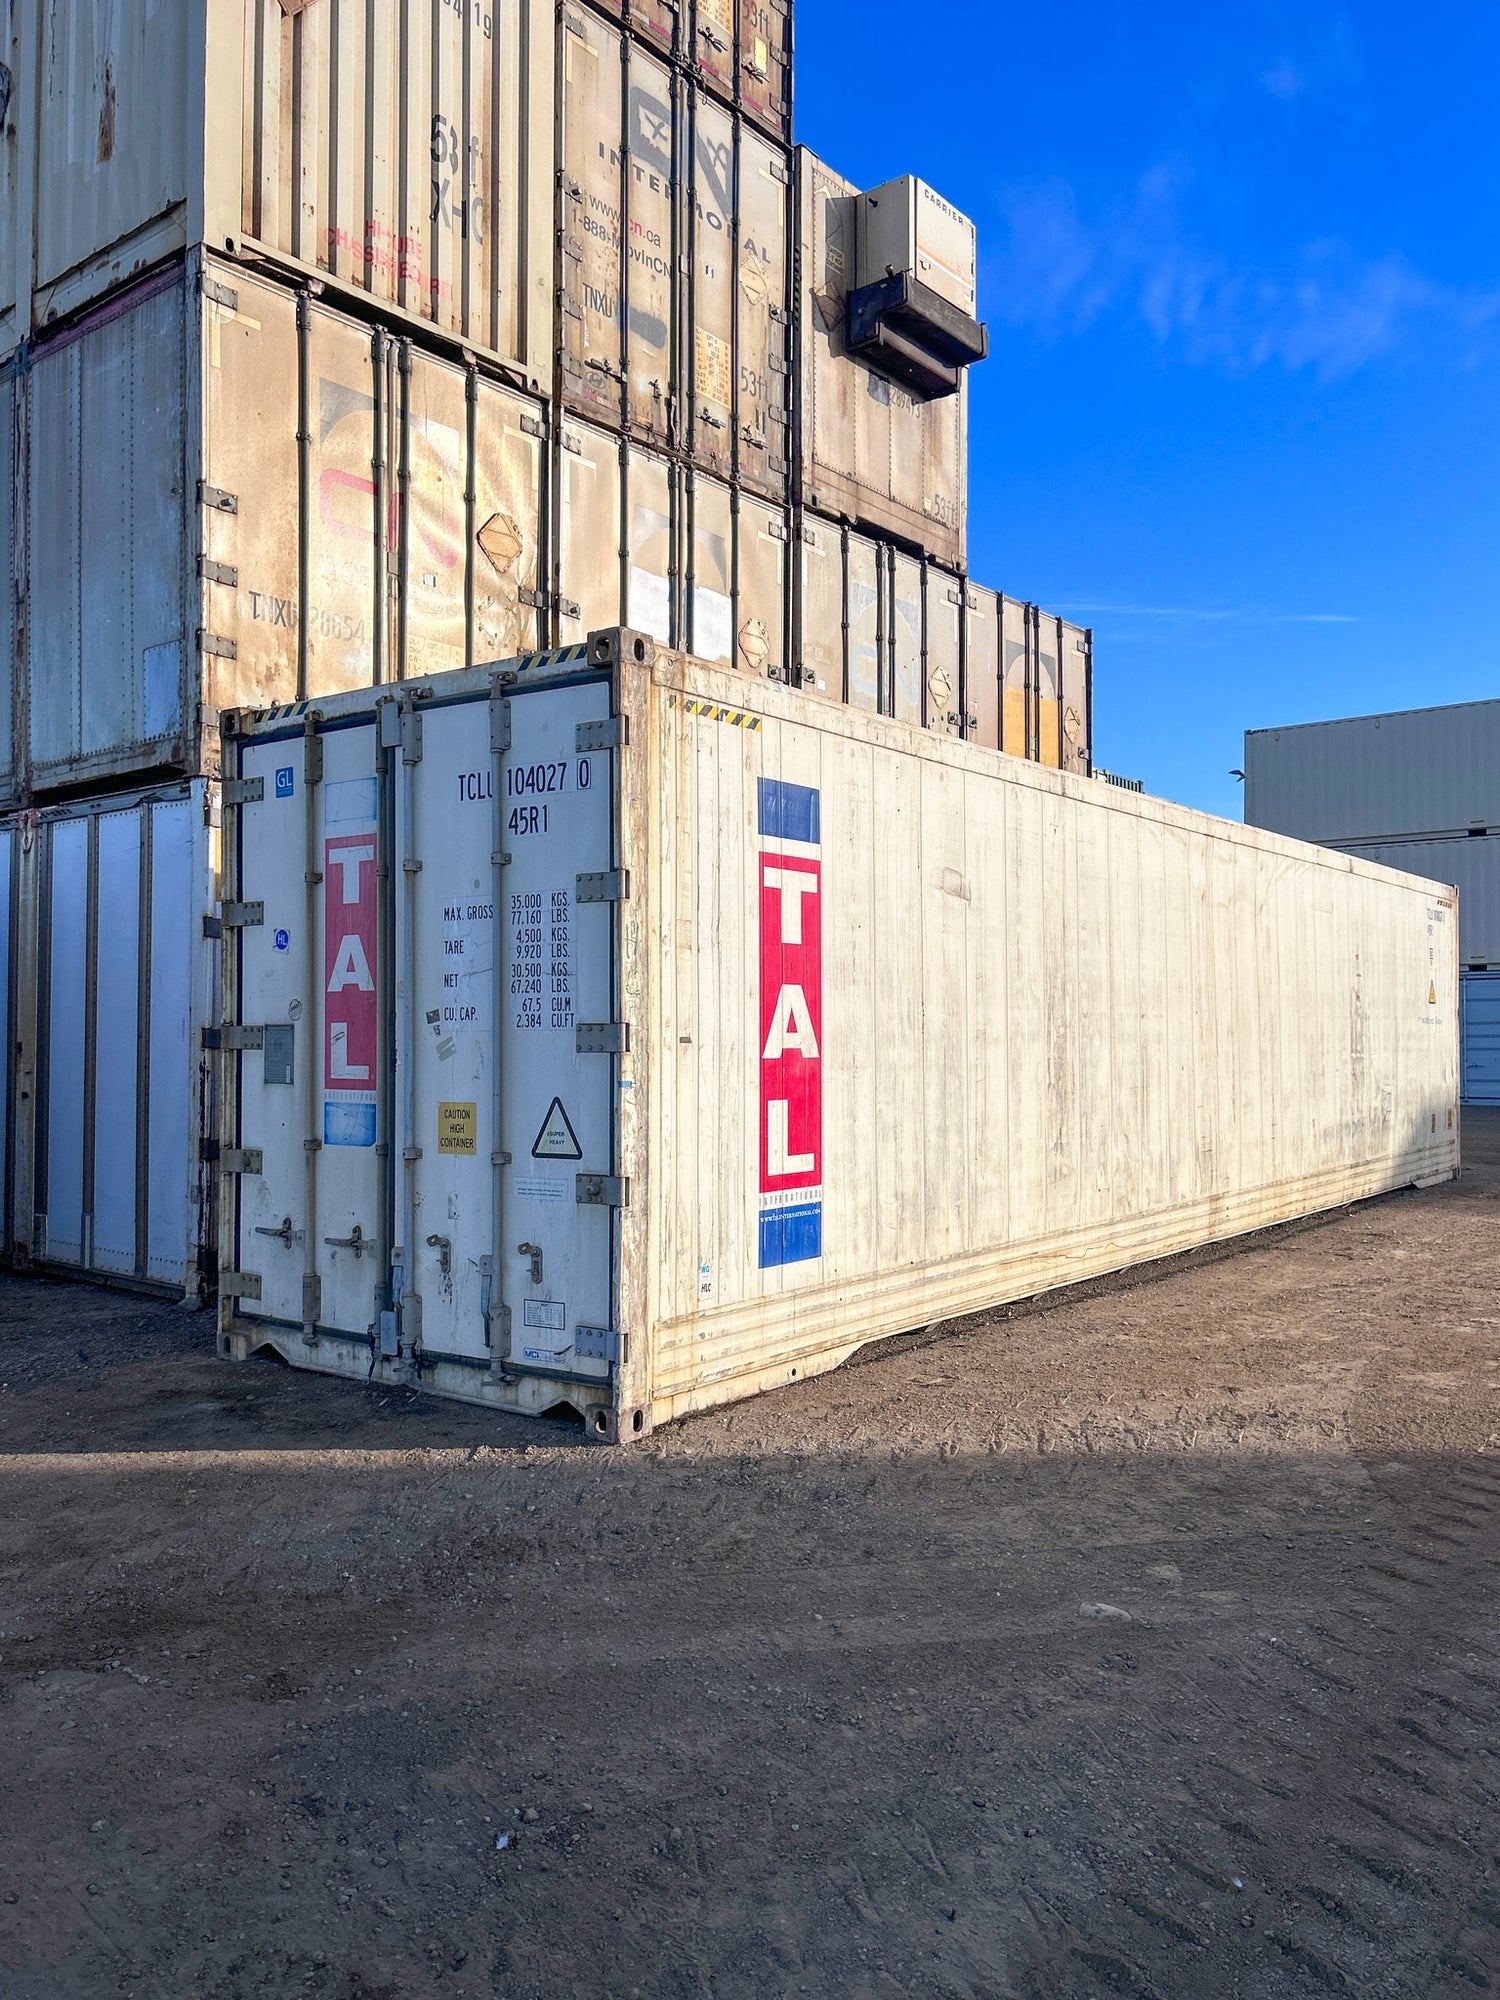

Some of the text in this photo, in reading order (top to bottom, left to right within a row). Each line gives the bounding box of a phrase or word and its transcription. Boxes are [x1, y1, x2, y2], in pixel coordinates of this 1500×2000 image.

[924, 188, 964, 225] CARRIER
[582, 282, 613, 318] TNXU
[248, 590, 298, 629] TNXU
[276, 770, 293, 788] GL
[507, 762, 567, 796] 104027
[579, 760, 589, 788] 0
[508, 804, 548, 835] 45R1
[551, 892, 571, 908] KGS.
[443, 904, 494, 921] MAX. GROSS
[551, 908, 571, 924] LBS.
[551, 927, 571, 943] KGS.
[444, 940, 465, 955] TARE
[551, 943, 571, 959] LBS.
[551, 962, 571, 978] KGS.
[443, 973, 459, 989] NET
[551, 978, 571, 994] LBS.
[522, 997, 542, 1013] 67.5
[443, 1006, 479, 1022] CU. CAP.
[761, 865, 821, 1178] TAL
[444, 1109, 471, 1120] CAUTION
[449, 1123, 465, 1134] HIGH
[440, 1137, 474, 1149] CONTAINER
